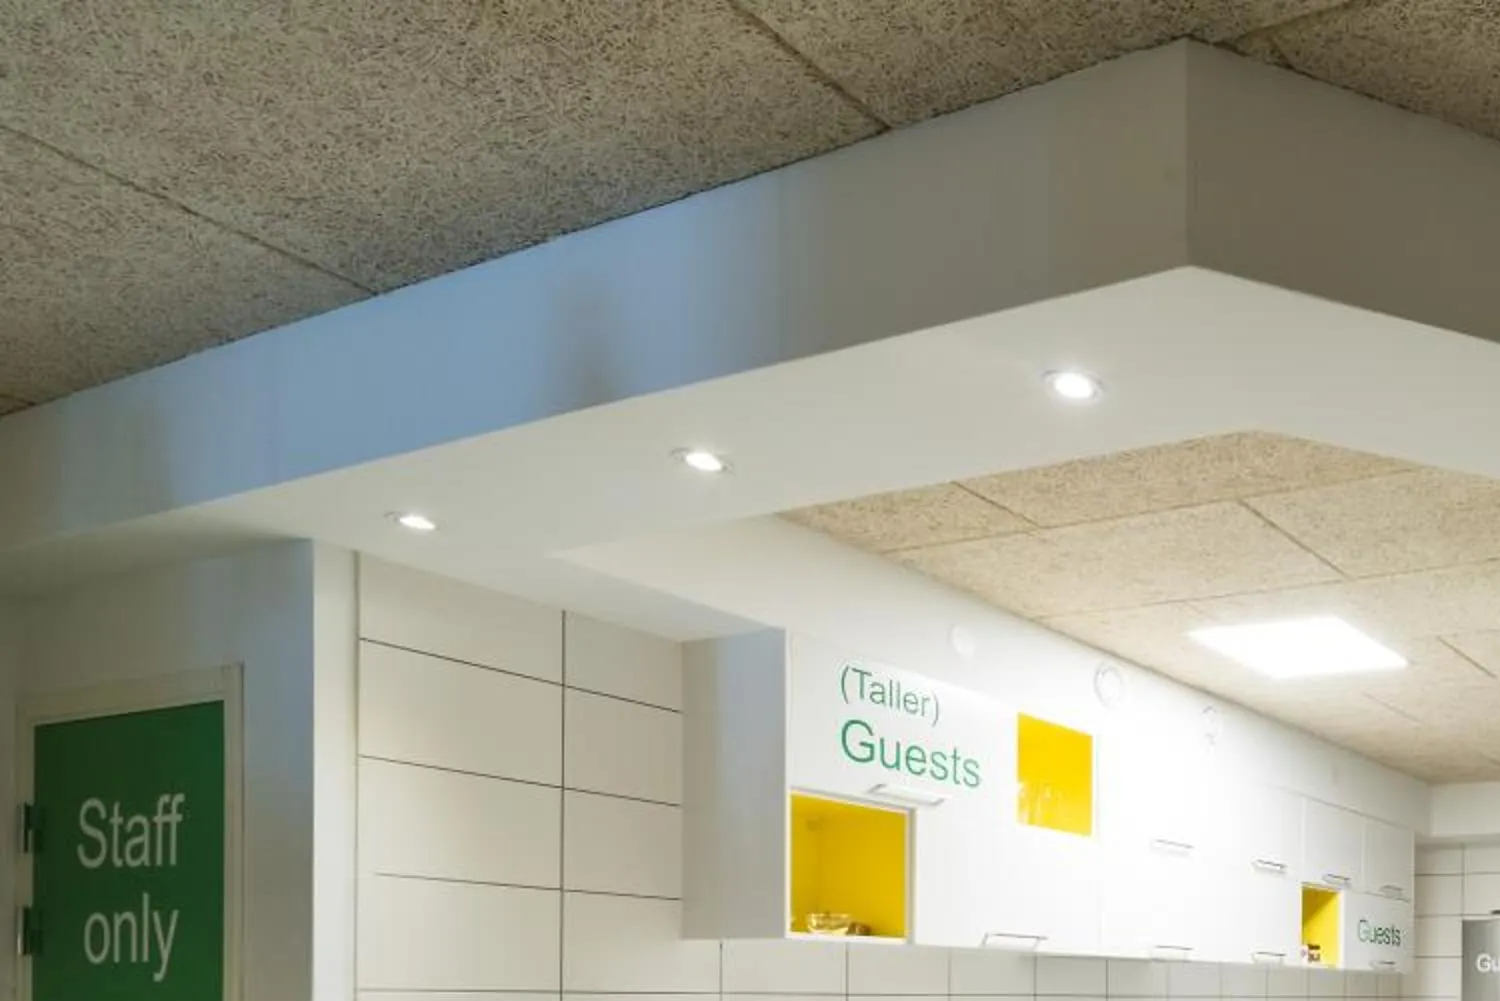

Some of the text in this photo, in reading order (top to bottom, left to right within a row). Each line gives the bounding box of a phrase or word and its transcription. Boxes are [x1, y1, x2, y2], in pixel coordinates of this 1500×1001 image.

[840, 663, 940, 725] (Taller)
[840, 718, 982, 789] Guests
[77, 793, 186, 869] Staff
[83, 893, 181, 982] only
[1358, 919, 1401, 947] Guests
